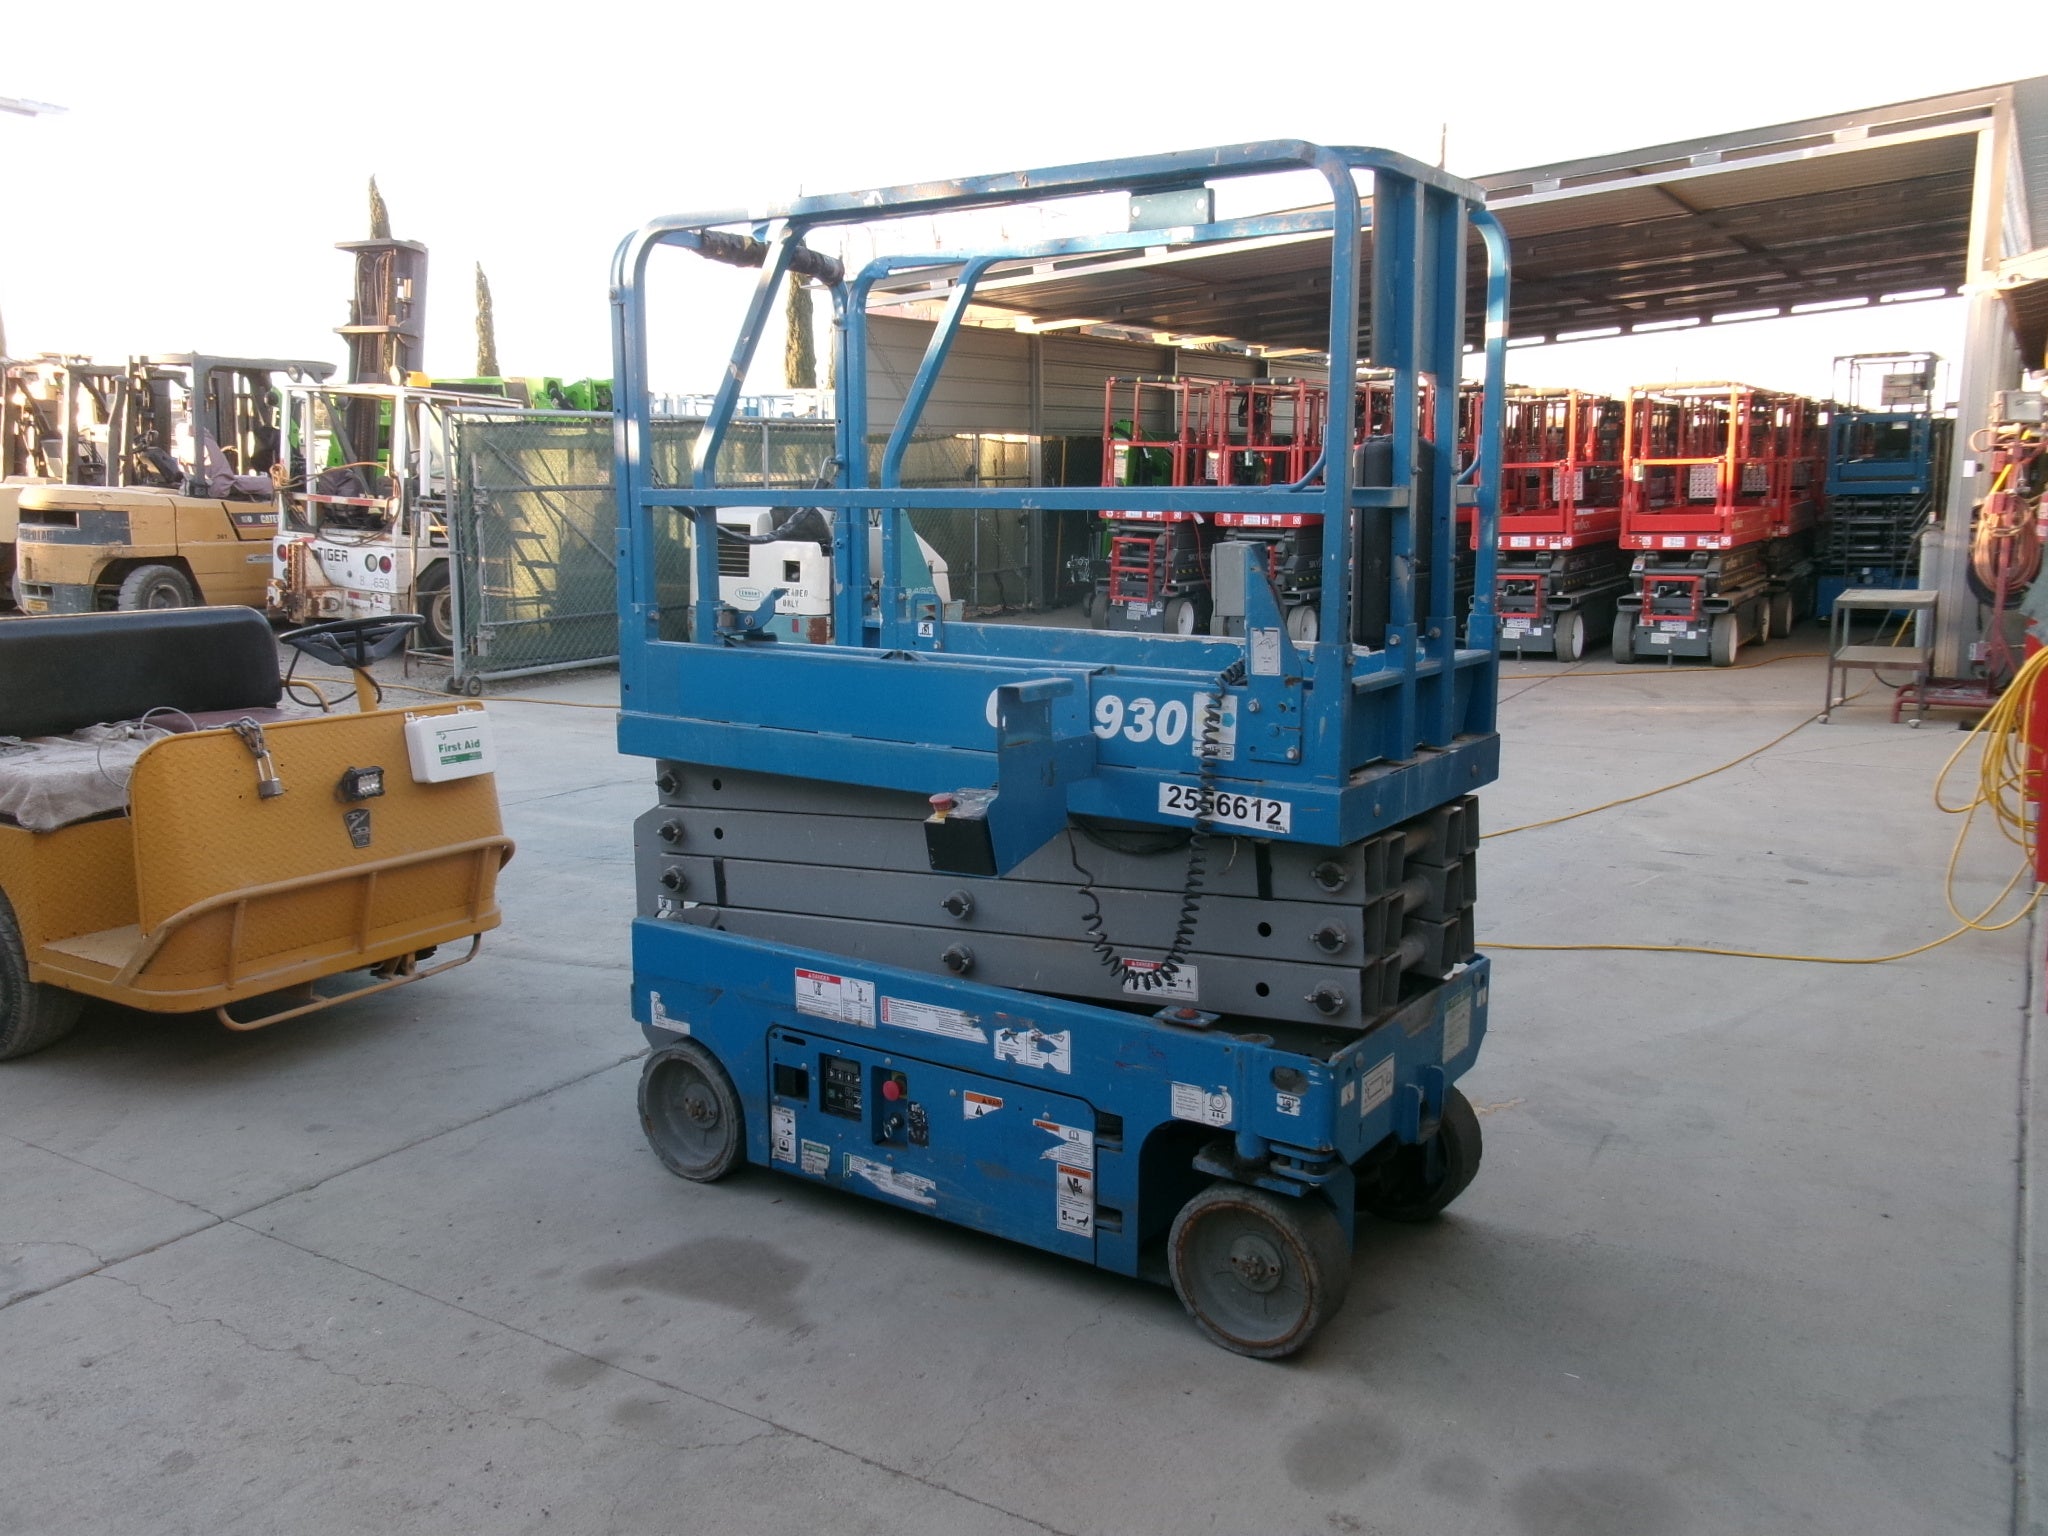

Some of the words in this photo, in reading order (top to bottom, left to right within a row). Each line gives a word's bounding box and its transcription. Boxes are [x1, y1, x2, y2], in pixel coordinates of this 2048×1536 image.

[317, 547, 349, 562] TIGER
[438, 742, 461, 753] First
[464, 739, 481, 749] Aid
